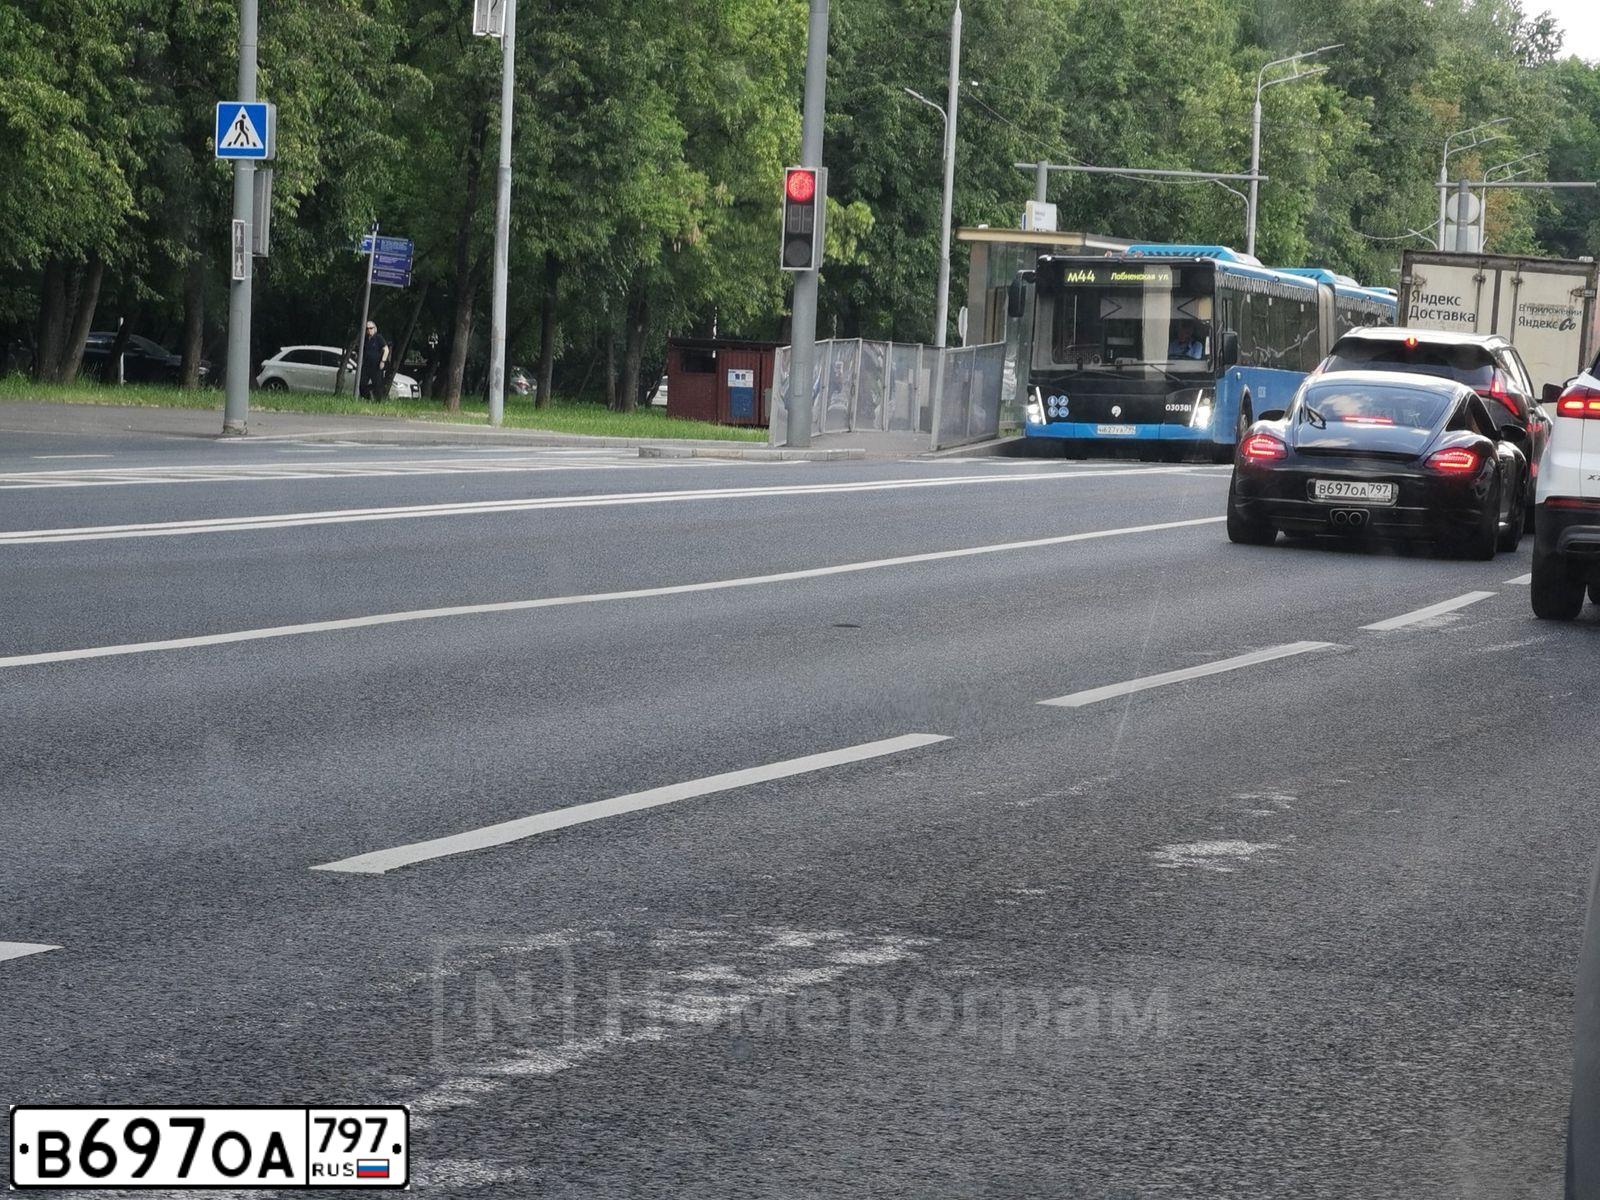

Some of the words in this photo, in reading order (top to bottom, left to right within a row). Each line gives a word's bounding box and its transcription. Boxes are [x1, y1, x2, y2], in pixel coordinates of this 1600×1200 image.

[1411, 290, 1462, 307] Яндекс
[1408, 305, 1476, 323] Доставка
[1518, 316, 1558, 329] Яндекс
[1558, 317, 1577, 331] Go
